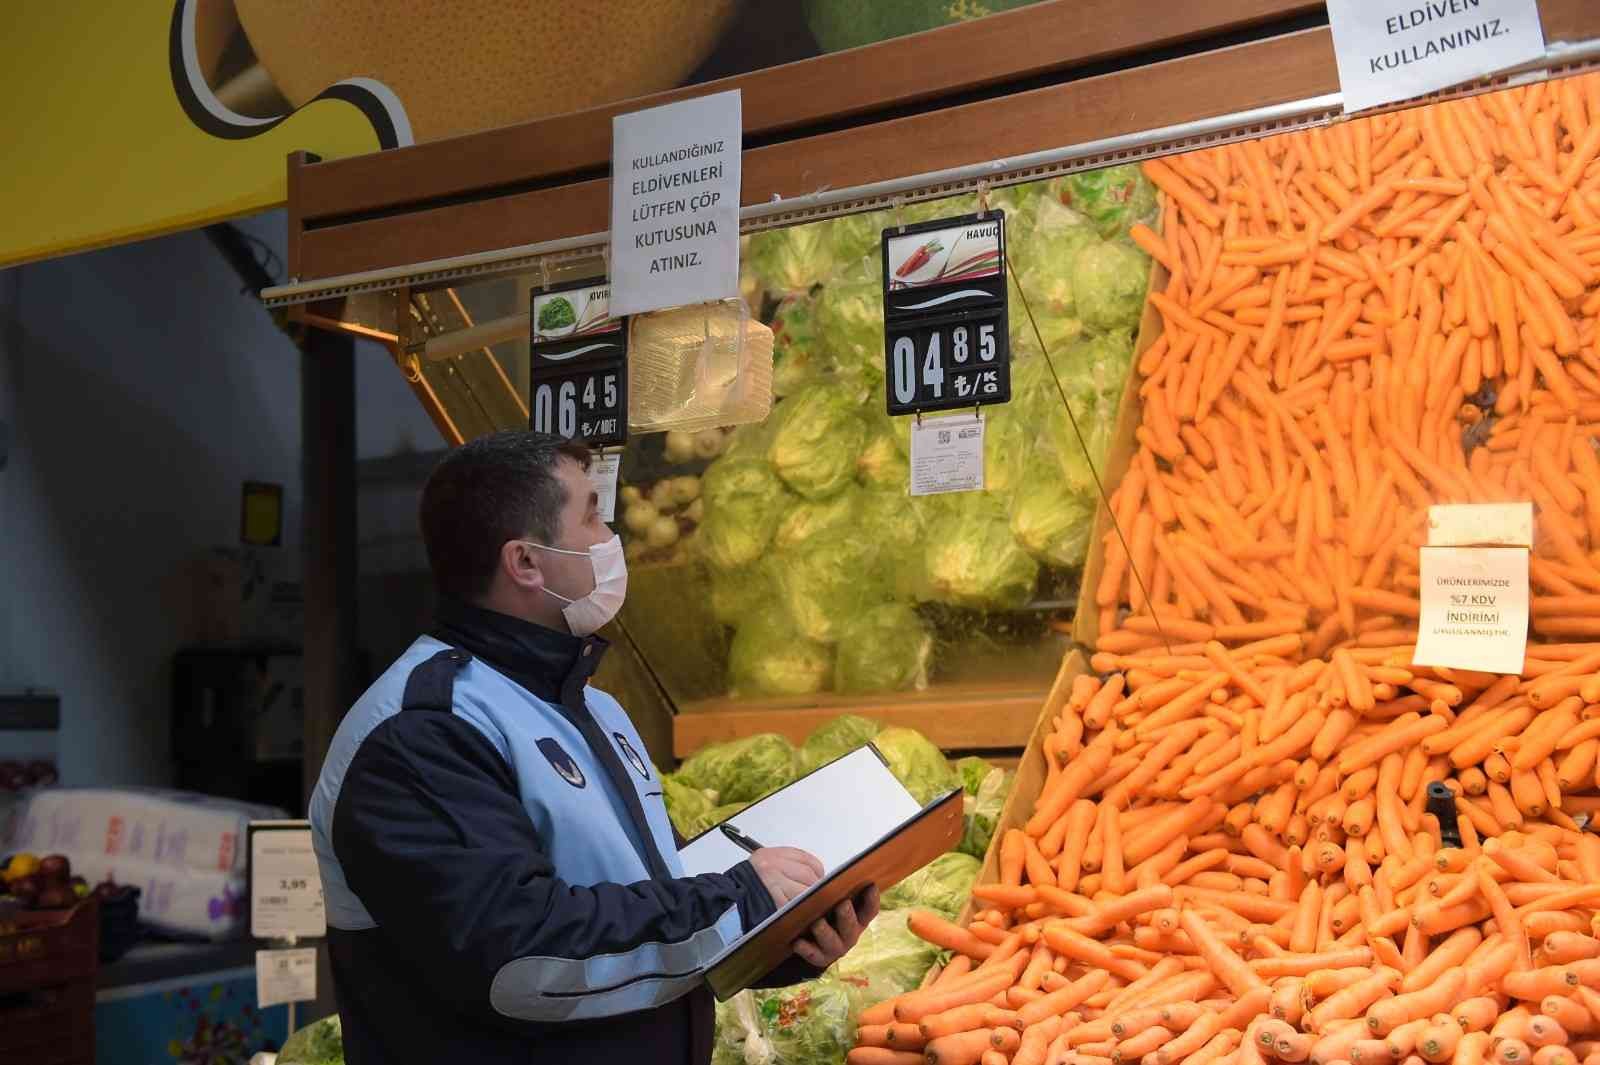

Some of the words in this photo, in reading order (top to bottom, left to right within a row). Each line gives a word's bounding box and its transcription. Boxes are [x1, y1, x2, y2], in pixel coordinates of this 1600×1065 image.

[1386, 0, 1480, 35] ELDİVEN
[1369, 18, 1510, 73] KULLANINIZ.
[632, 140, 725, 170] KULLANDIĞINIZ
[632, 161, 723, 196] ELDİVENLERİ
[632, 198, 686, 222] LÜTFEN
[690, 191, 721, 216] ÇÖP
[635, 220, 718, 249] KUTUSUNA
[649, 251, 702, 274] ATINIZ.
[1471, 594, 1497, 606] KDV
